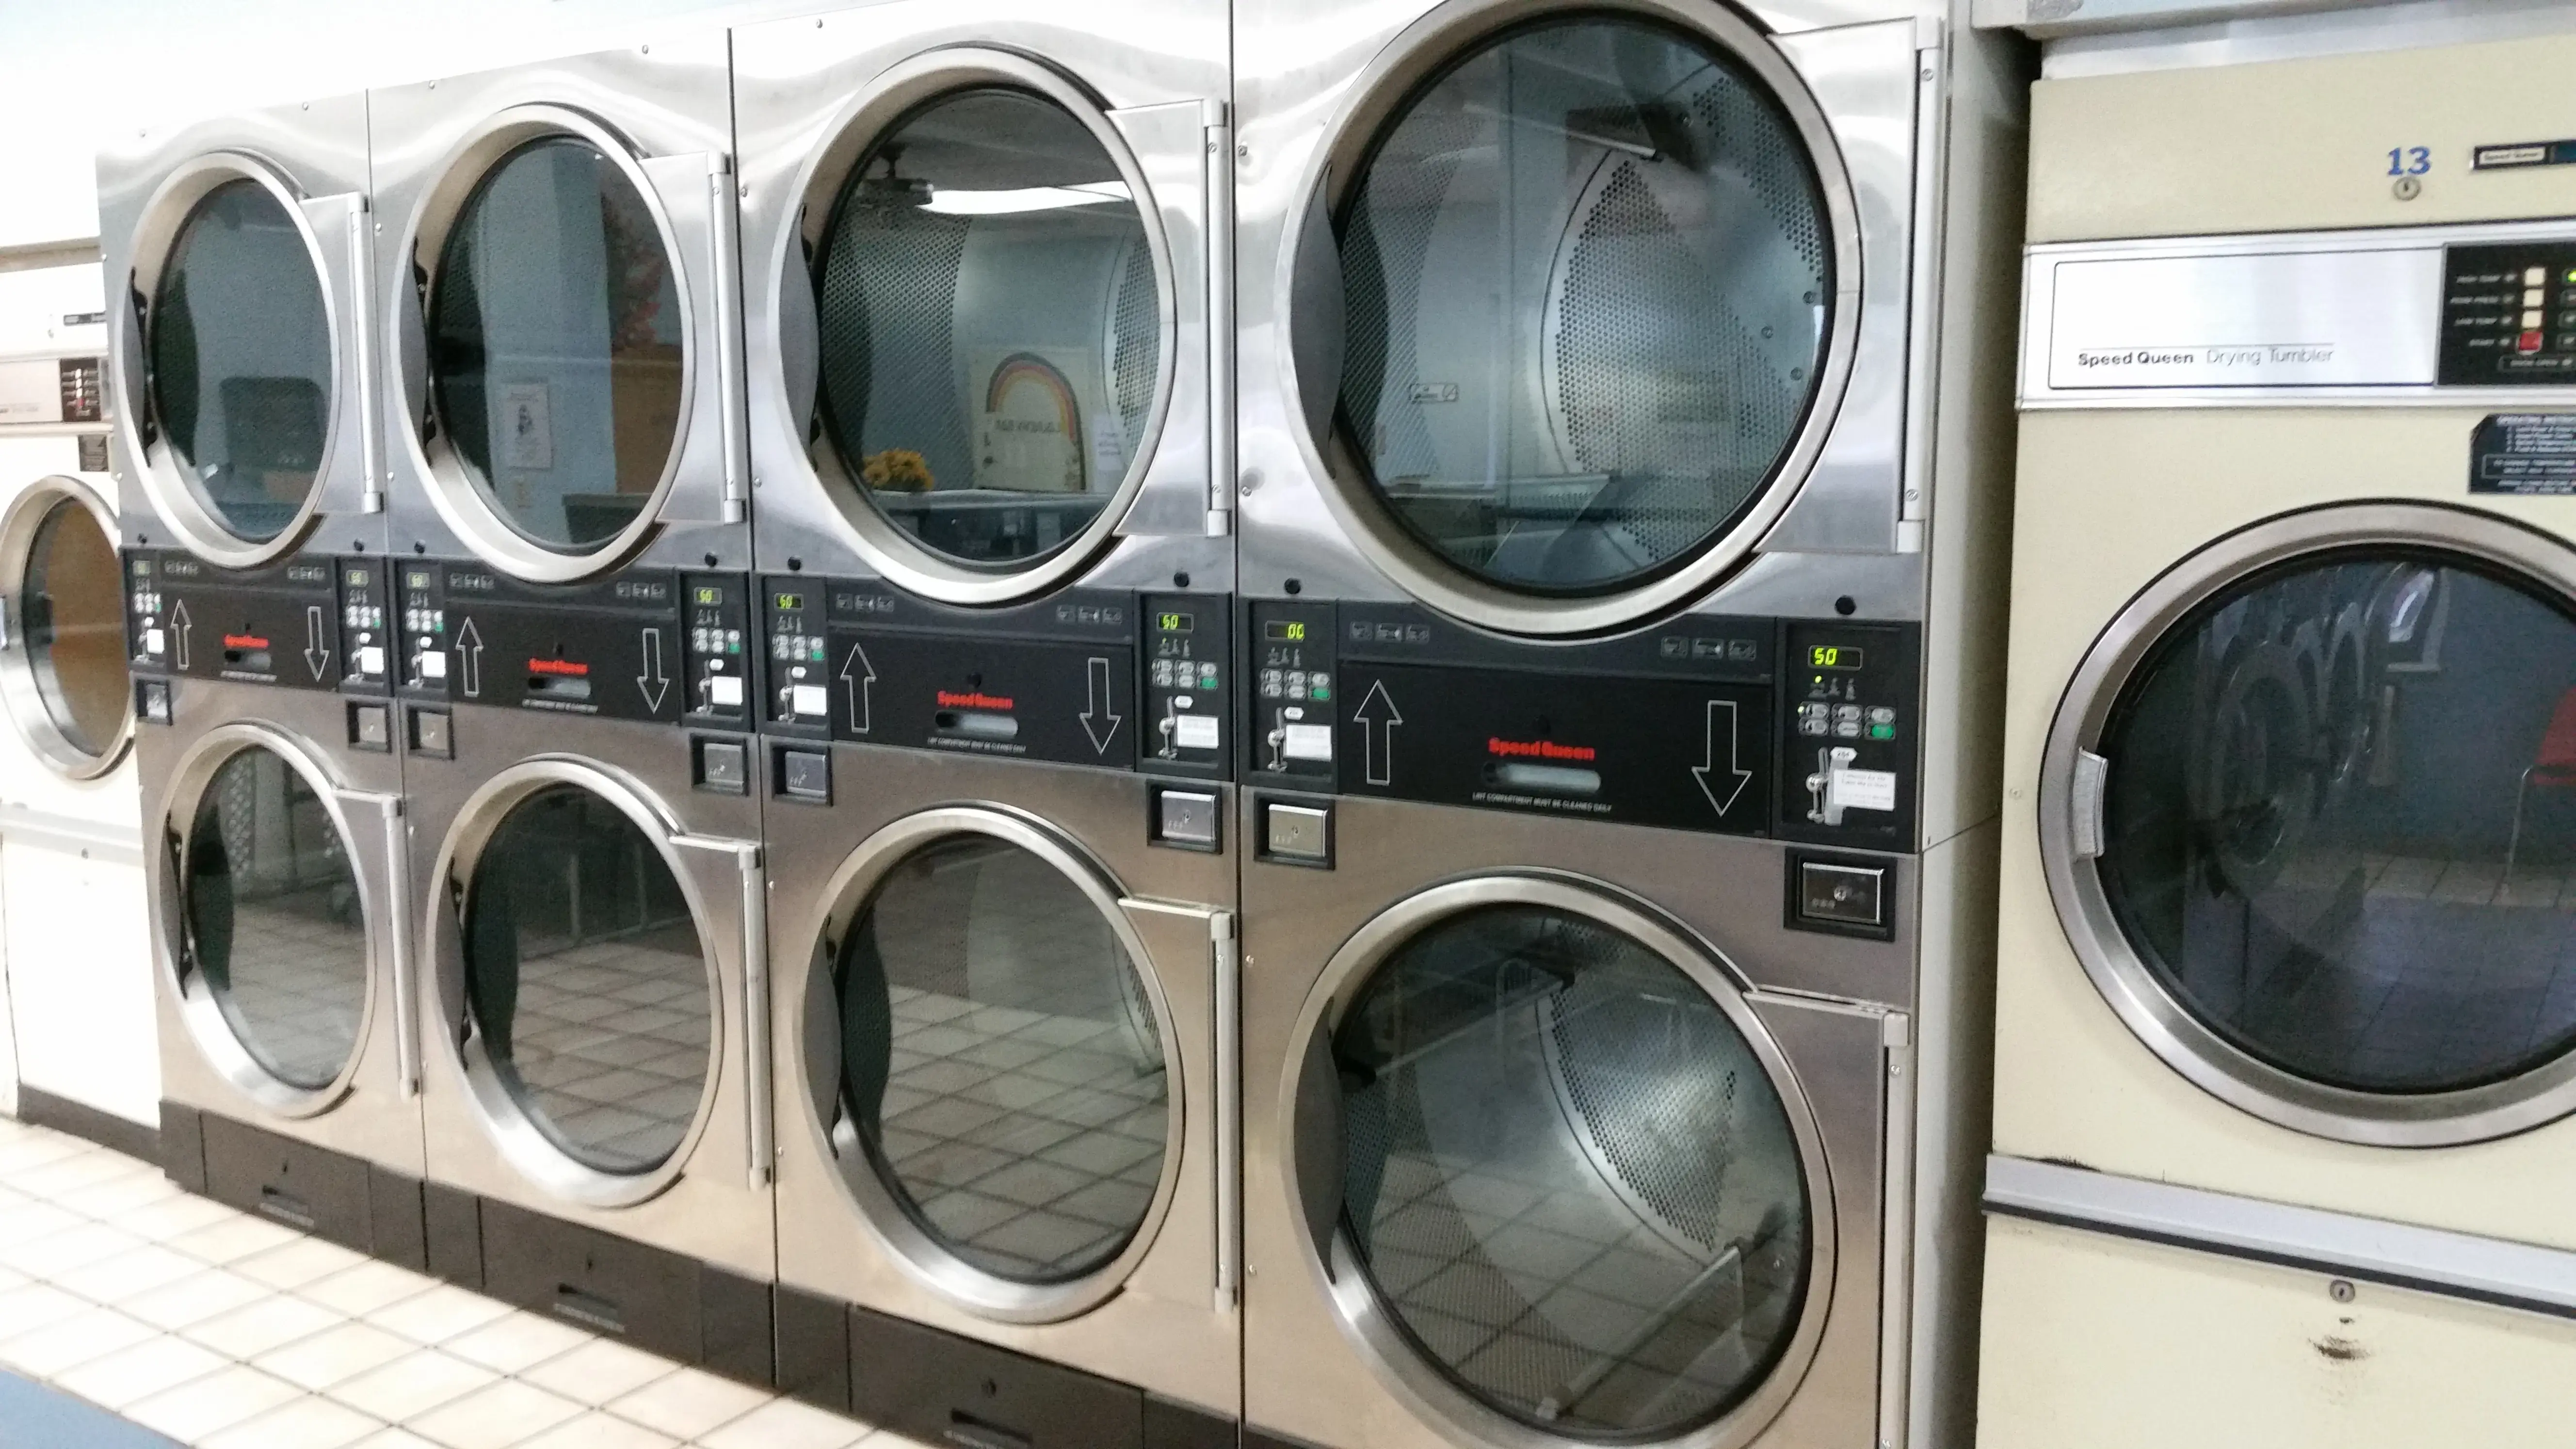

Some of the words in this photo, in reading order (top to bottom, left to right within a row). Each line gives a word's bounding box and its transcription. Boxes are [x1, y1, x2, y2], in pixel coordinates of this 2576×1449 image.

[2387, 146, 2431, 176] 13
[2078, 351, 2133, 368] Speed
[2137, 351, 2193, 365] Queen
[2206, 348, 2262, 367] Drying
[2268, 346, 2335, 363] Tumbler
[1814, 647, 1837, 665] 50
[1488, 737, 1541, 757] Speed
[1541, 741, 1595, 761] Queen
